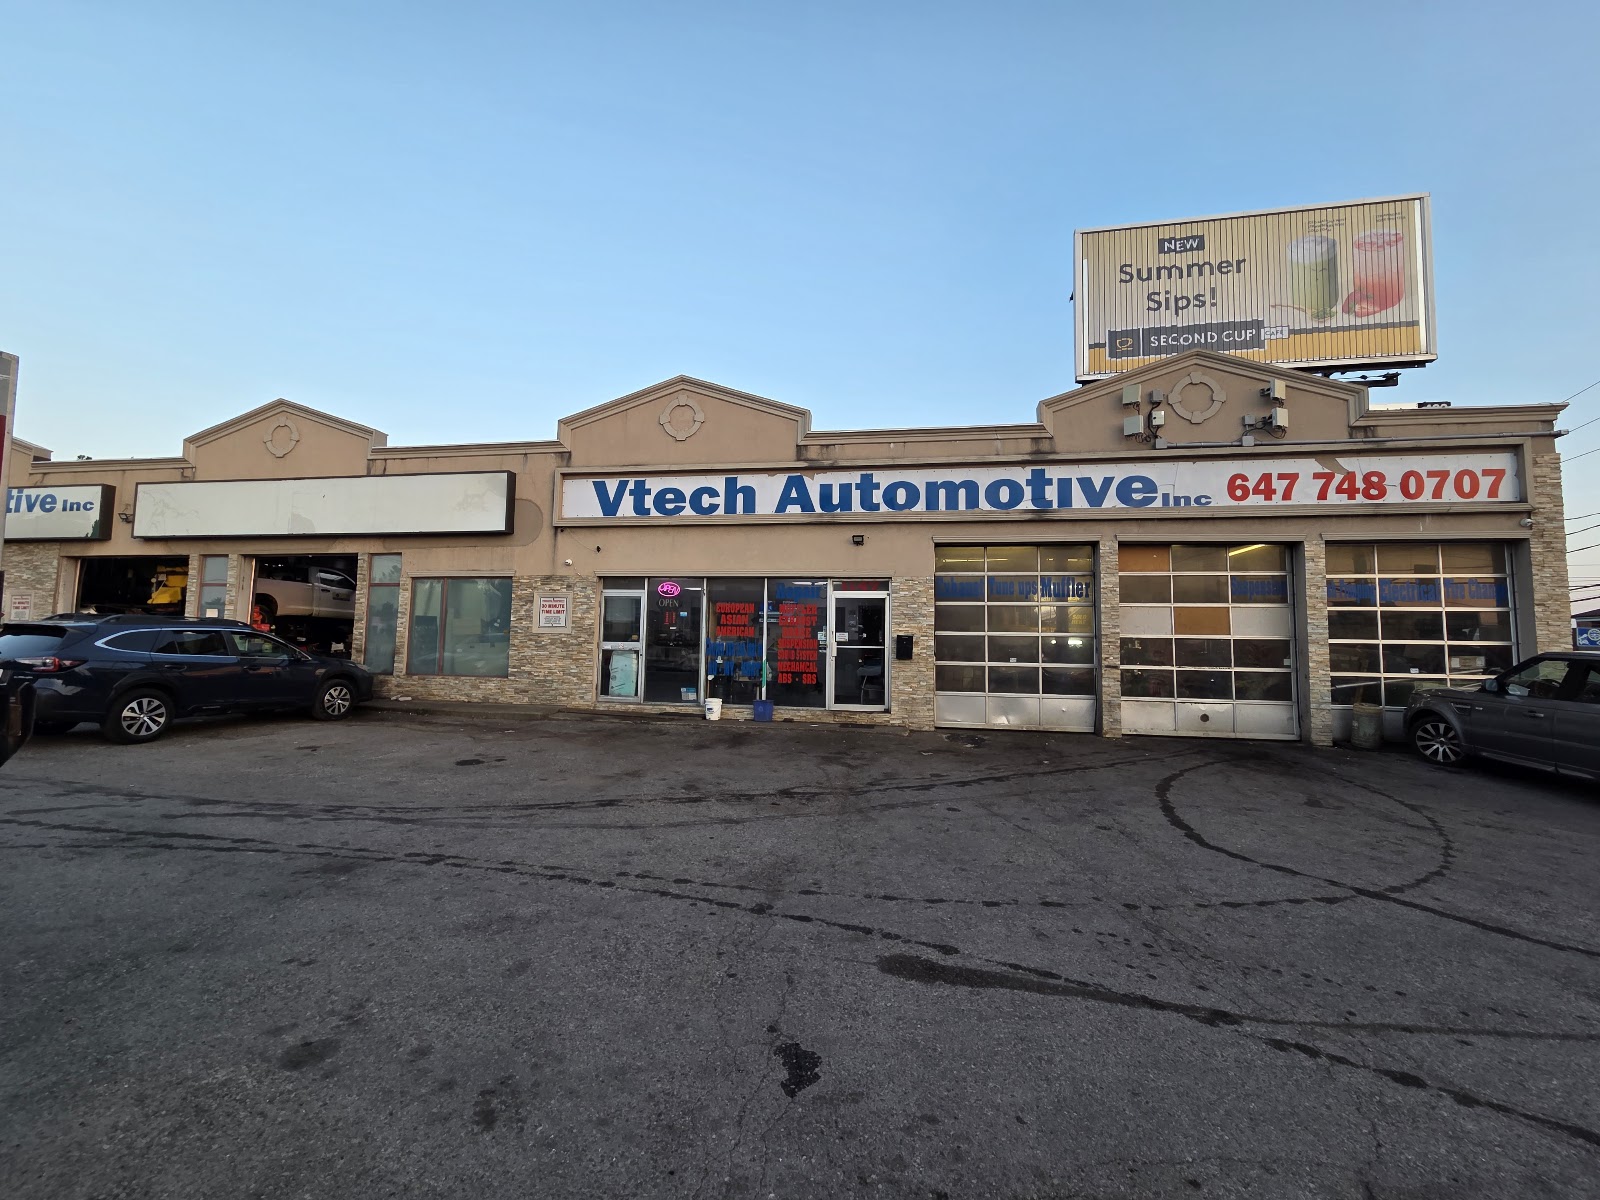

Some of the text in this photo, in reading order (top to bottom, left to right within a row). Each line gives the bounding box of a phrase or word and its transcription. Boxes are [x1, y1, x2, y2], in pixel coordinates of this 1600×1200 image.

[1164, 238, 1199, 251] NEW
[1119, 258, 1246, 283] Summer
[1146, 286, 1217, 317] Sips!
[1150, 329, 1256, 347] SECOND CUP
[1227, 468, 1506, 502] 647 748 0707
[592, 468, 1212, 517] Vtech Automotive Inc
[62, 499, 95, 512] Inc
[659, 583, 679, 594] OPEN
[988, 576, 1014, 595] Tune
[1041, 577, 1090, 598] Muffler
[1380, 578, 1440, 601] Electrical
[659, 599, 679, 607] OPEN
[716, 602, 754, 613] EUROPEAN
[721, 615, 748, 624] ASIAN
[716, 626, 754, 636] AMERICAN
[778, 639, 817, 649] SUSPENSION
[796, 650, 817, 660] SYSTEM
[778, 674, 816, 684] ABS SRS
